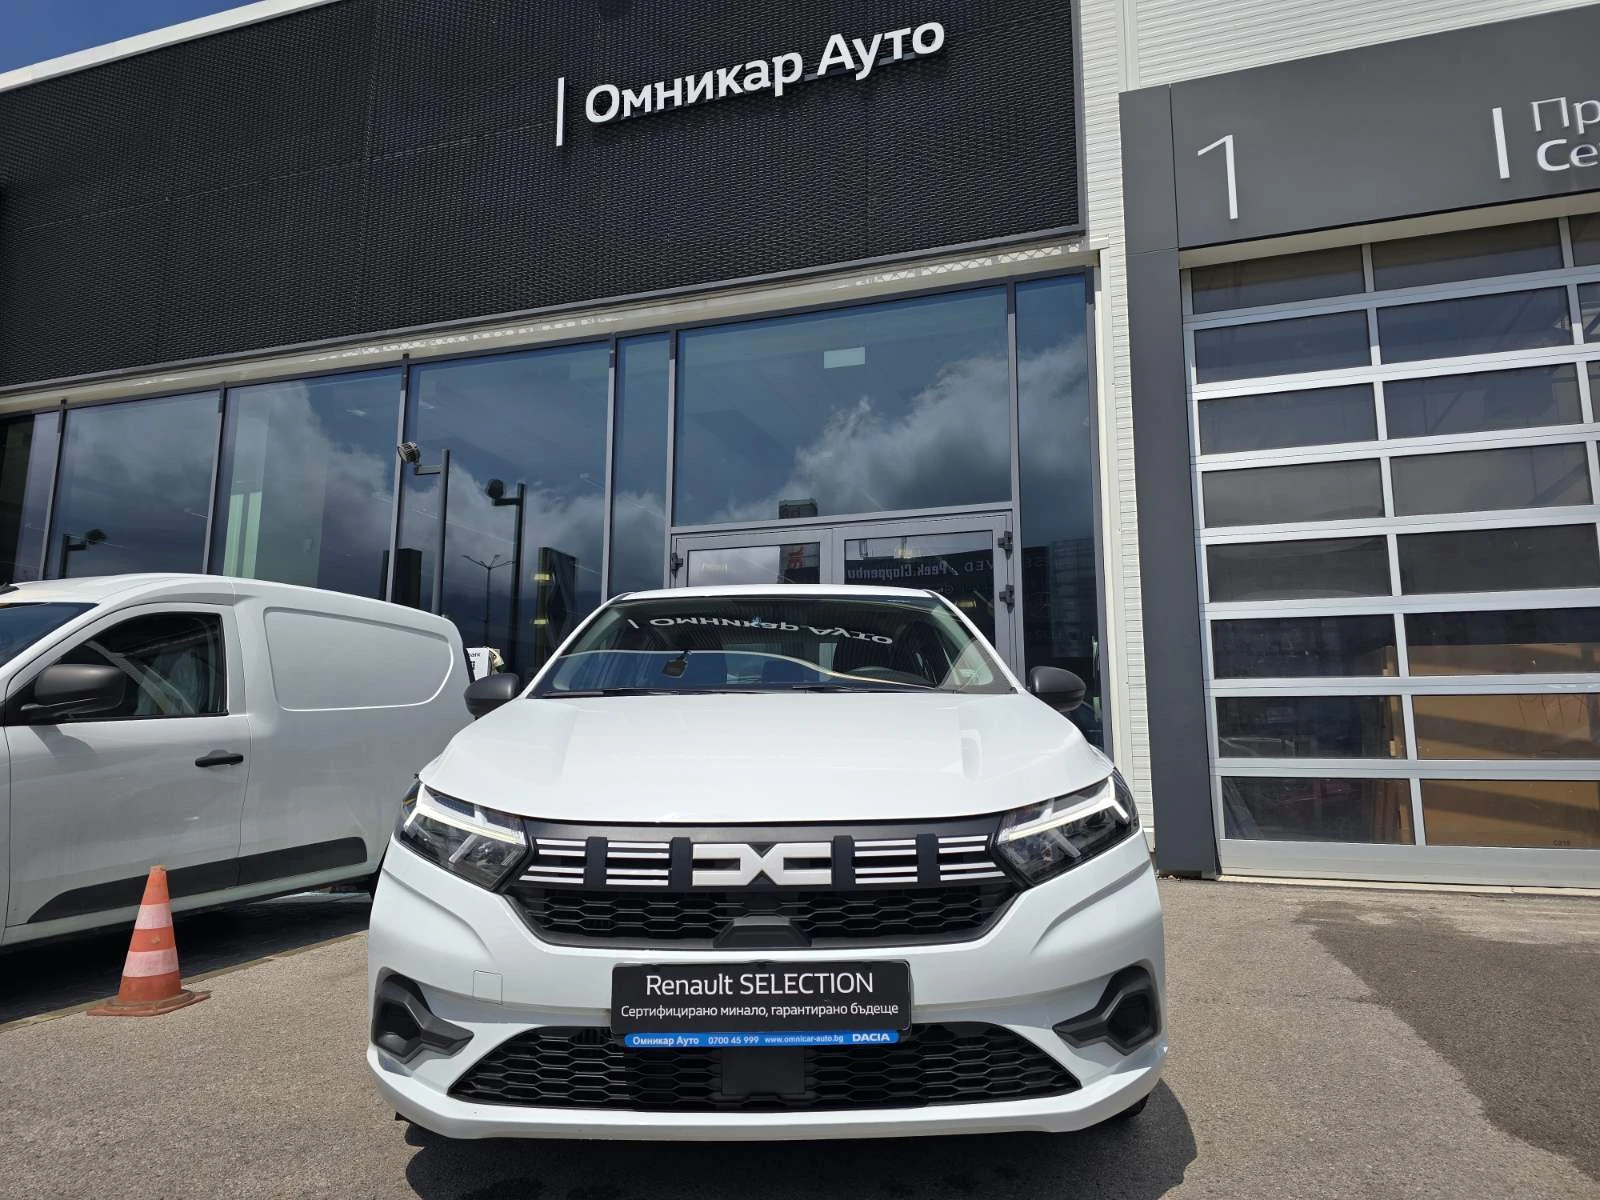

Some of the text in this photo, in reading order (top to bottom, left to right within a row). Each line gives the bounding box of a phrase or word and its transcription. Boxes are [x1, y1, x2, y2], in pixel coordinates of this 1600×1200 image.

[585, 21, 945, 124] Омникар Ауто
[1197, 134, 1239, 220] 1
[646, 972, 874, 996] Renault SELECTION
[621, 1002, 899, 1019] Сертифицирано минало, гарантирано бъдеще
[633, 1036, 699, 1046] Омникар Ауто
[707, 1036, 729, 1045] 0700
[743, 1035, 760, 1044] 999
[764, 1034, 844, 1043] www.omnicar-auto.bg
[852, 1033, 891, 1042] DACIA
